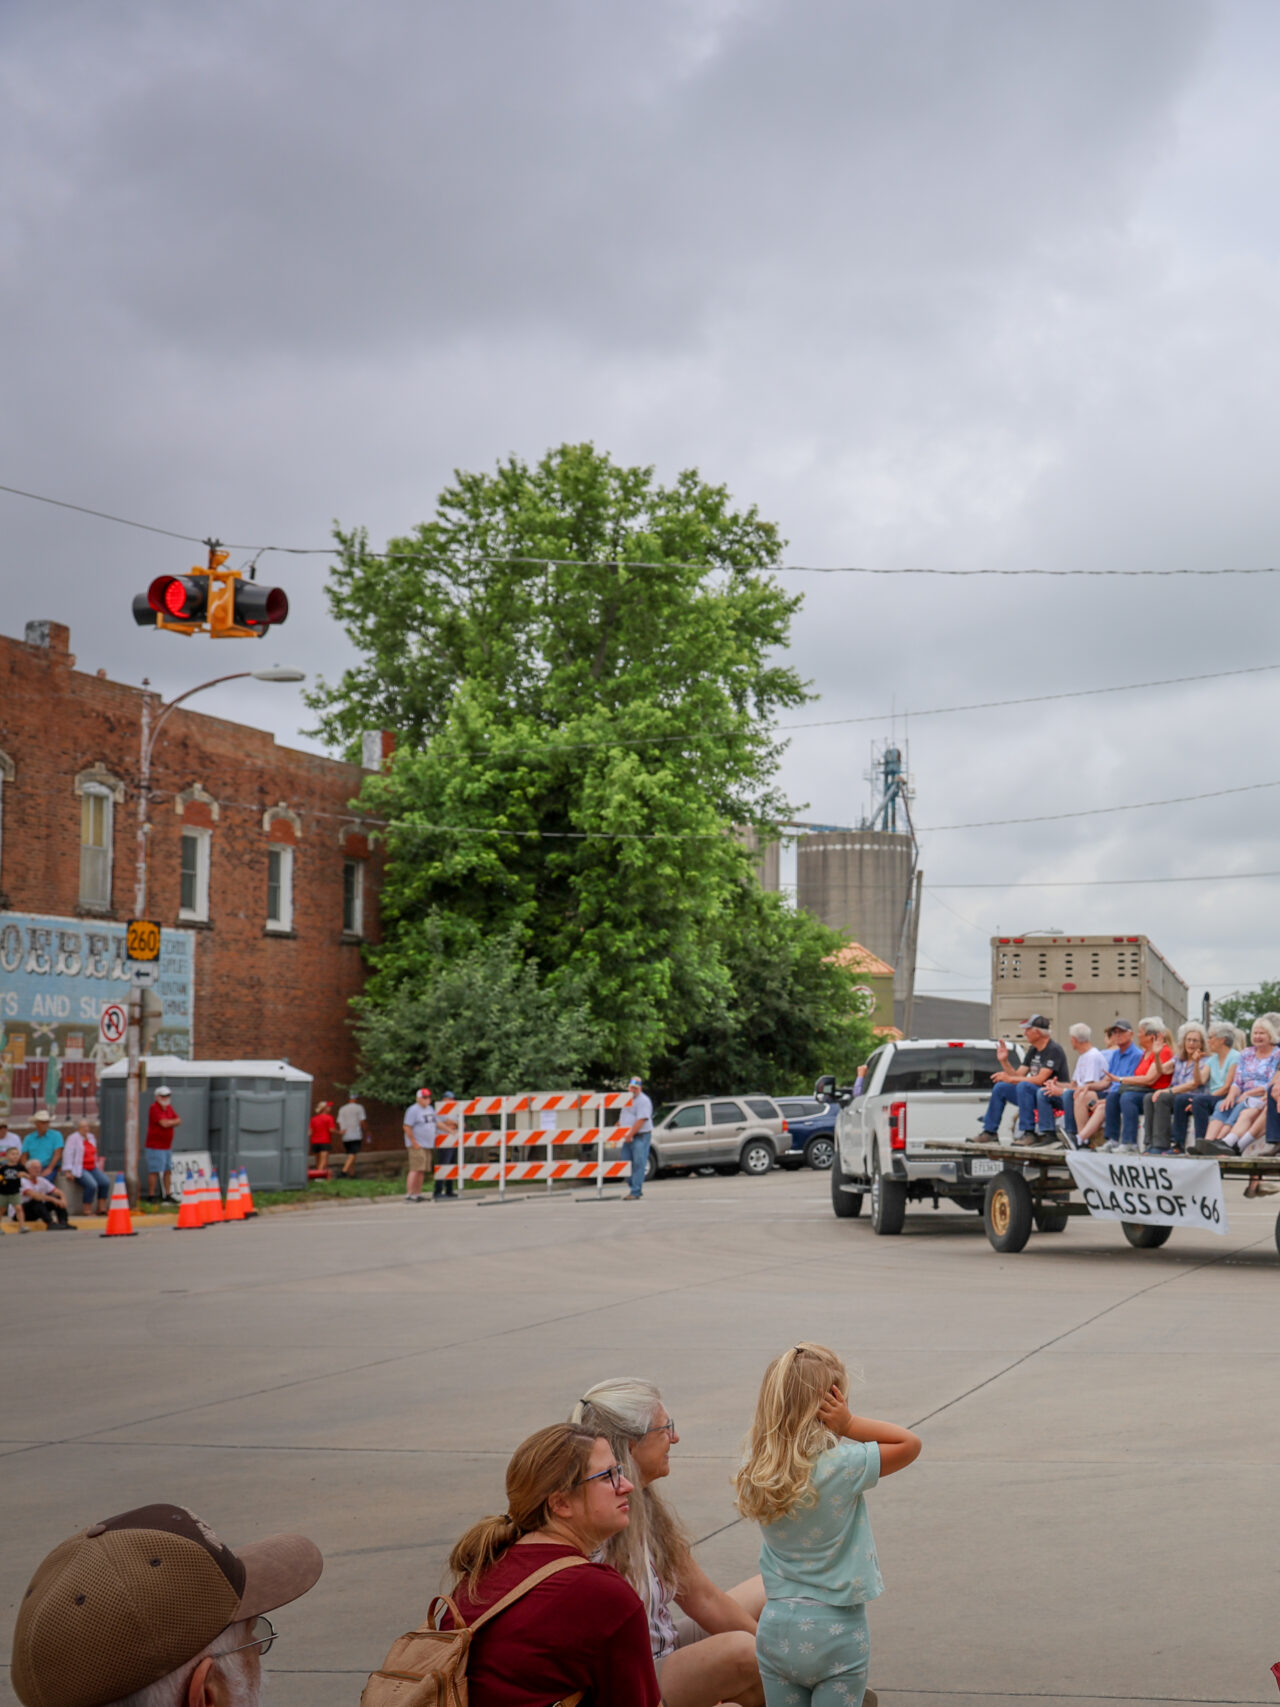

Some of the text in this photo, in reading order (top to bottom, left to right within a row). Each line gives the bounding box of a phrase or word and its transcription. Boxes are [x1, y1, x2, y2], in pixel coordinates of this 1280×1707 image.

[130, 929, 157, 952] 260
[31, 993, 71, 1018] AND
[1109, 1164, 1173, 1191] MRHS
[1083, 1187, 1220, 1224] CLASS OF '66
